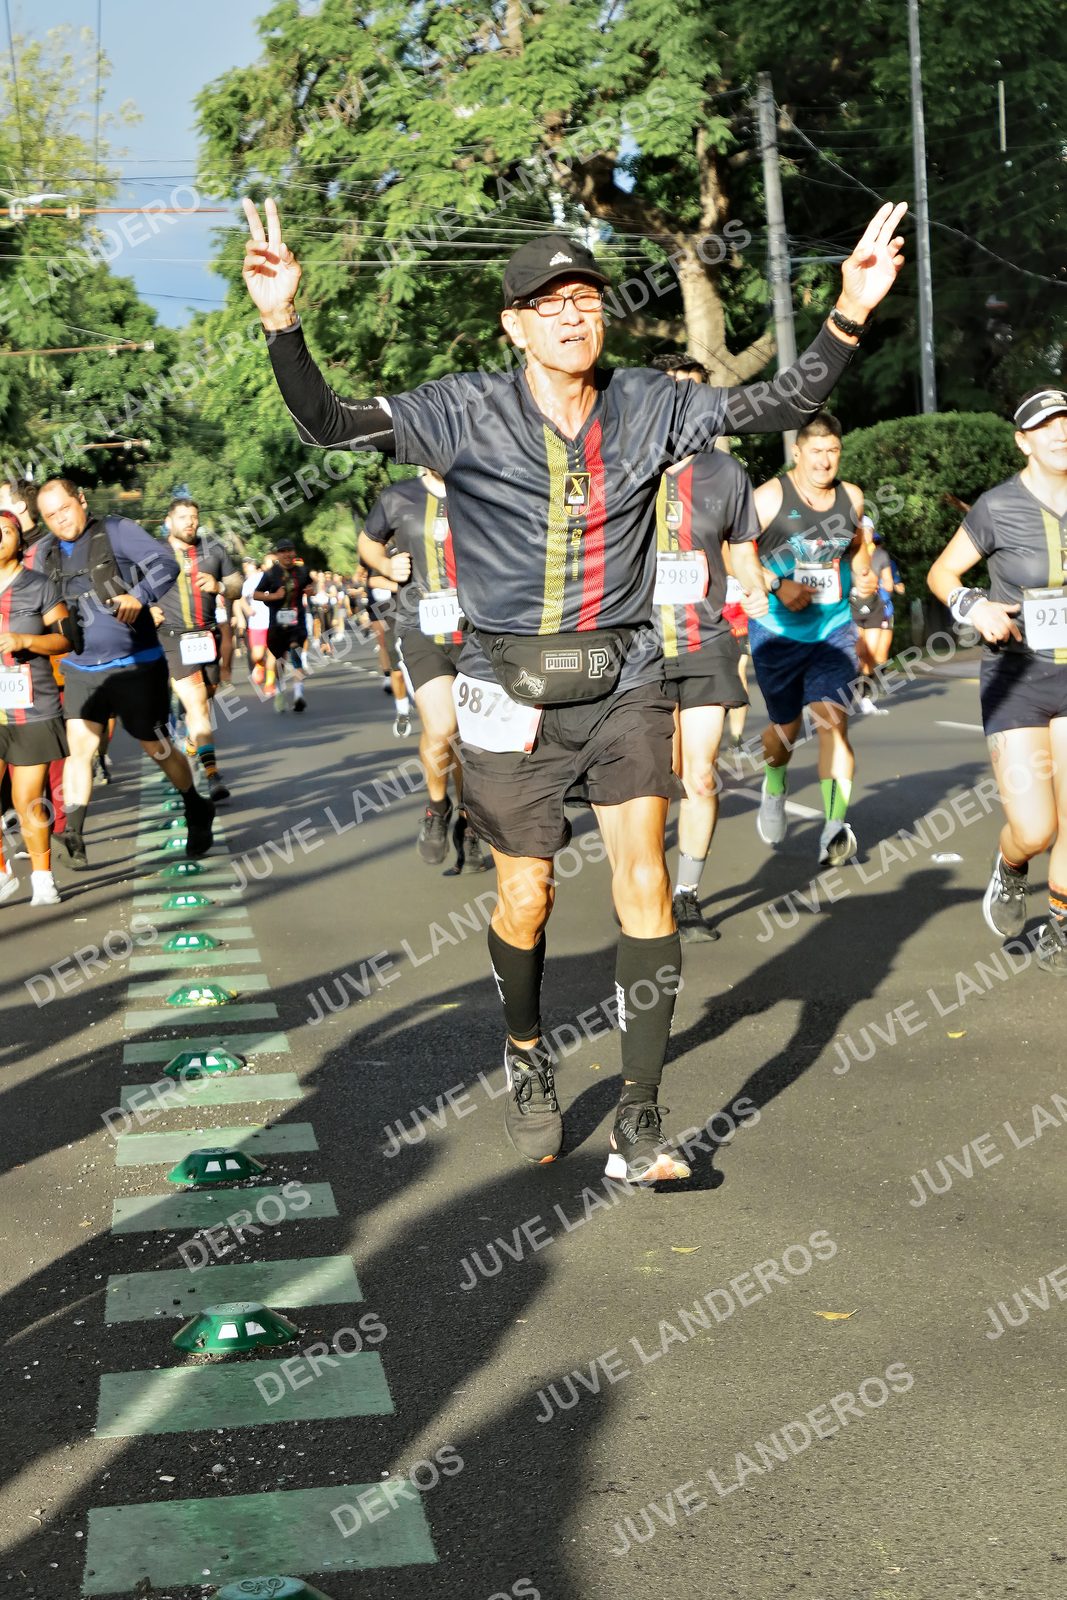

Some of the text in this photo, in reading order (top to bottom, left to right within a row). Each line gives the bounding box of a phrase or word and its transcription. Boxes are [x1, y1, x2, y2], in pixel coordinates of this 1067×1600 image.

[657, 568, 699, 585] 2989
[546, 657, 577, 669] PUMA
[588, 648, 609, 678] P
